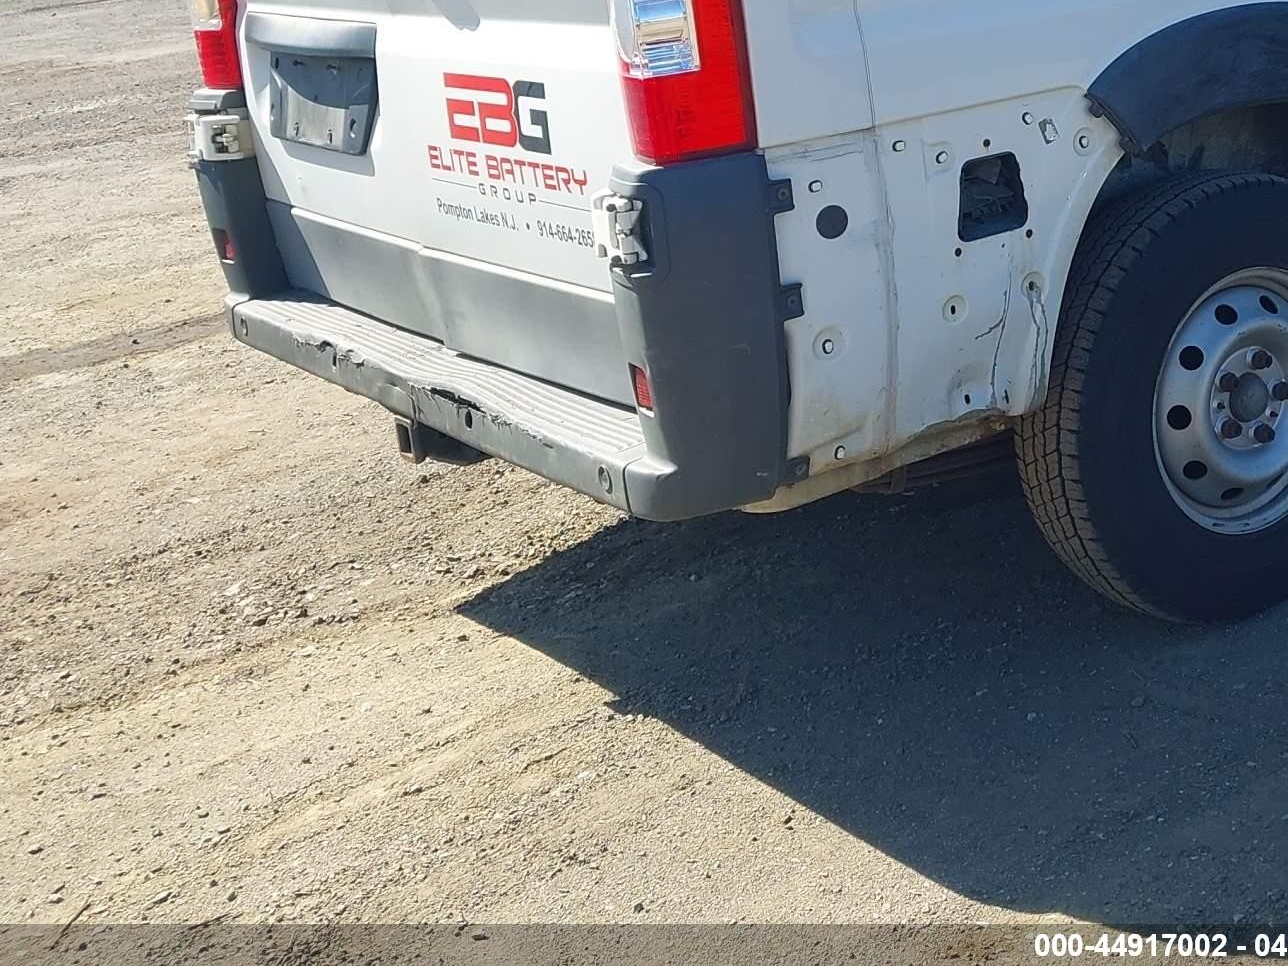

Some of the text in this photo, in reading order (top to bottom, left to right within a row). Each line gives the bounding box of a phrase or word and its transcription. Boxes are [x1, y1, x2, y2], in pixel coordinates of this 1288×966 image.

[443, 72, 553, 155] EBG
[427, 145, 588, 195] ELITE BATTERY
[478, 183, 537, 206] GROUP
[436, 197, 594, 248] Pompton Lakes N.J. 914-664-265
